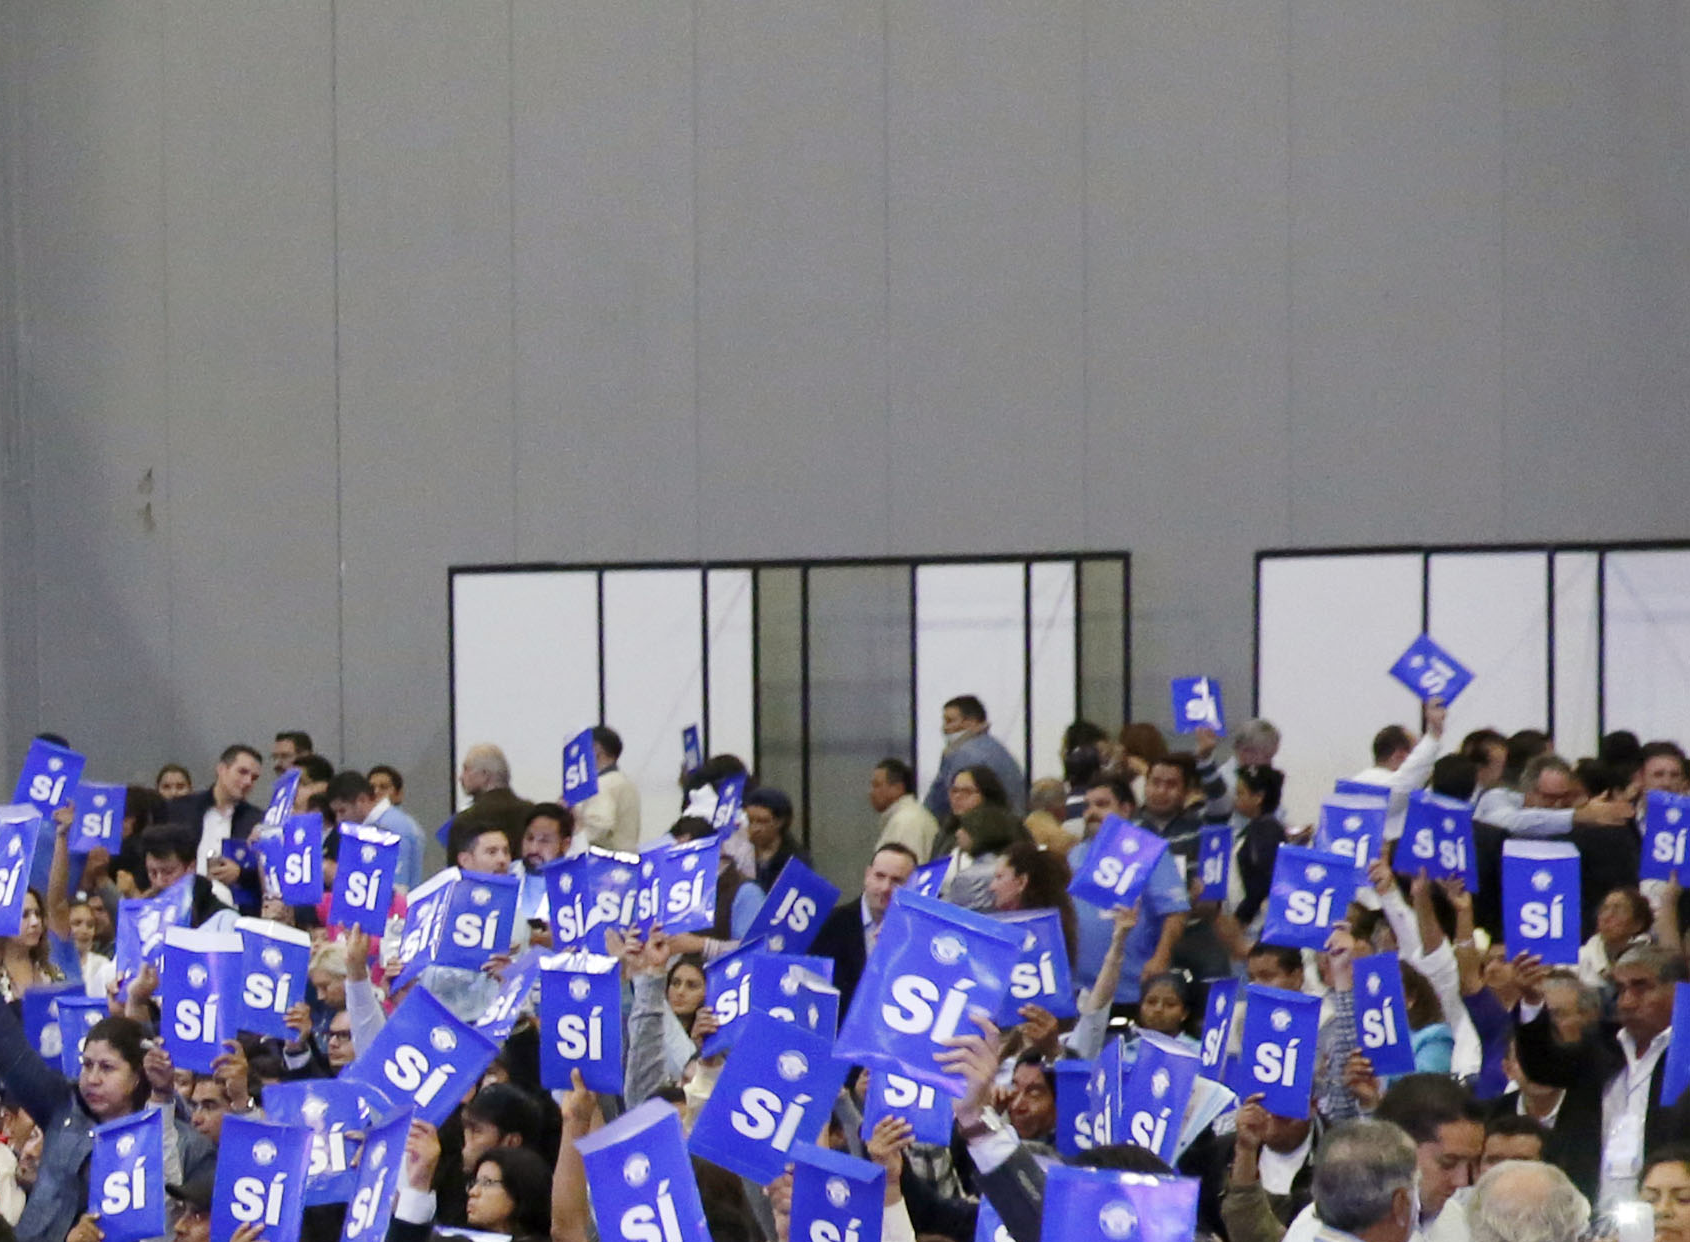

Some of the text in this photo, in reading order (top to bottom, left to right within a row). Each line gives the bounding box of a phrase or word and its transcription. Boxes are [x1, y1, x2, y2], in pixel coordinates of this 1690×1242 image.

[30, 775, 66, 805] SÍ
[566, 754, 587, 789] SÍ
[82, 810, 112, 837] SÍ
[285, 847, 311, 884] SÍ
[1326, 834, 1370, 867] SÍ
[1439, 837, 1466, 870] SÍ
[1653, 829, 1687, 864] SÍ
[345, 869, 381, 910] SÍ
[1093, 856, 1143, 895] SÍ
[1203, 853, 1223, 884] SÍ
[639, 878, 659, 919] SÍ
[667, 870, 703, 916] SÍ
[1281, 885, 1334, 927] SÍ
[453, 911, 499, 949] SÍ
[558, 893, 587, 942] SÍ
[1520, 895, 1563, 938] SÍ
[243, 973, 291, 1013] SÍ
[1010, 952, 1055, 998] SÍ
[175, 992, 219, 1042] SÍ
[712, 974, 750, 1025] SÍ
[882, 975, 979, 1044] SÍ
[557, 1006, 603, 1060] SÍ
[1363, 997, 1397, 1048] SÍ
[385, 1045, 455, 1107] SÍ
[1254, 1039, 1300, 1086] SÍ
[731, 1088, 811, 1152] SÍ
[102, 1156, 145, 1214] SÍ
[231, 1173, 287, 1227] SÍ
[347, 1167, 388, 1238] SÍ
